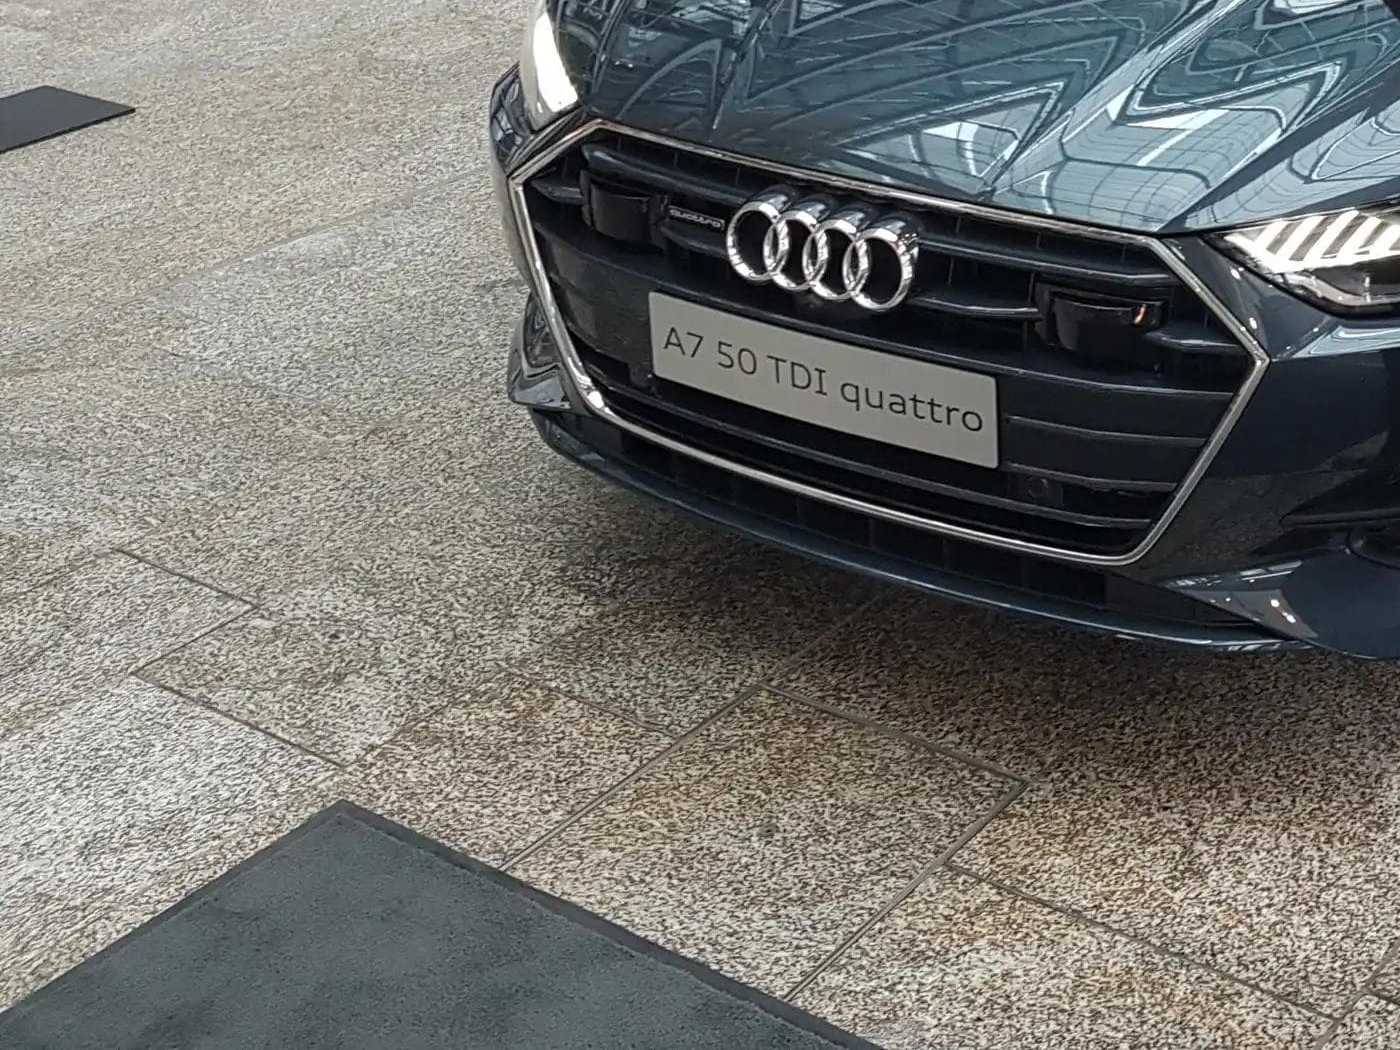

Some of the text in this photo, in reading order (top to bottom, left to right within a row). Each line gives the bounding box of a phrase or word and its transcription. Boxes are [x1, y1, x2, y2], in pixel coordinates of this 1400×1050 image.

[669, 209, 721, 228] quattro
[662, 326, 984, 433] A7 50 TDI quattro
